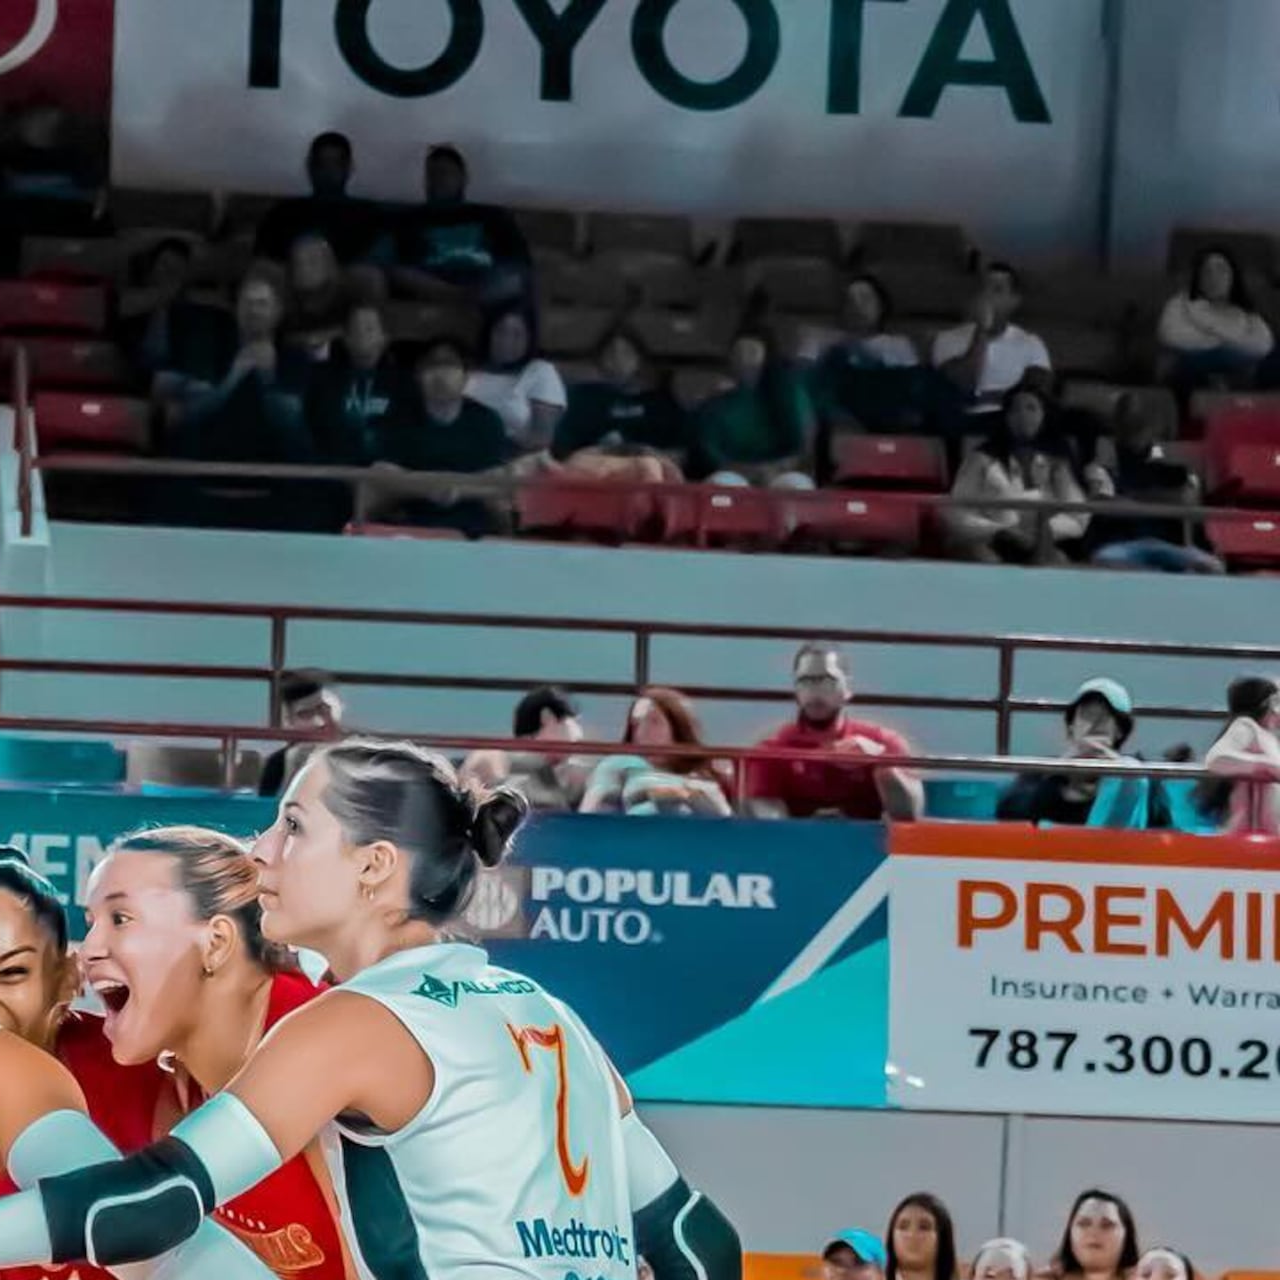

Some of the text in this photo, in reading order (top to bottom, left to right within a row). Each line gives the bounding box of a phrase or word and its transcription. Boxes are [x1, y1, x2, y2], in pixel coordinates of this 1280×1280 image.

[530, 867, 777, 908] POPULAR
[956, 879, 1280, 962] PREMI
[990, 975, 1149, 1004] Insurance
[967, 1026, 1280, 1080] 787.300.2
[506, 1022, 589, 1197] 7
